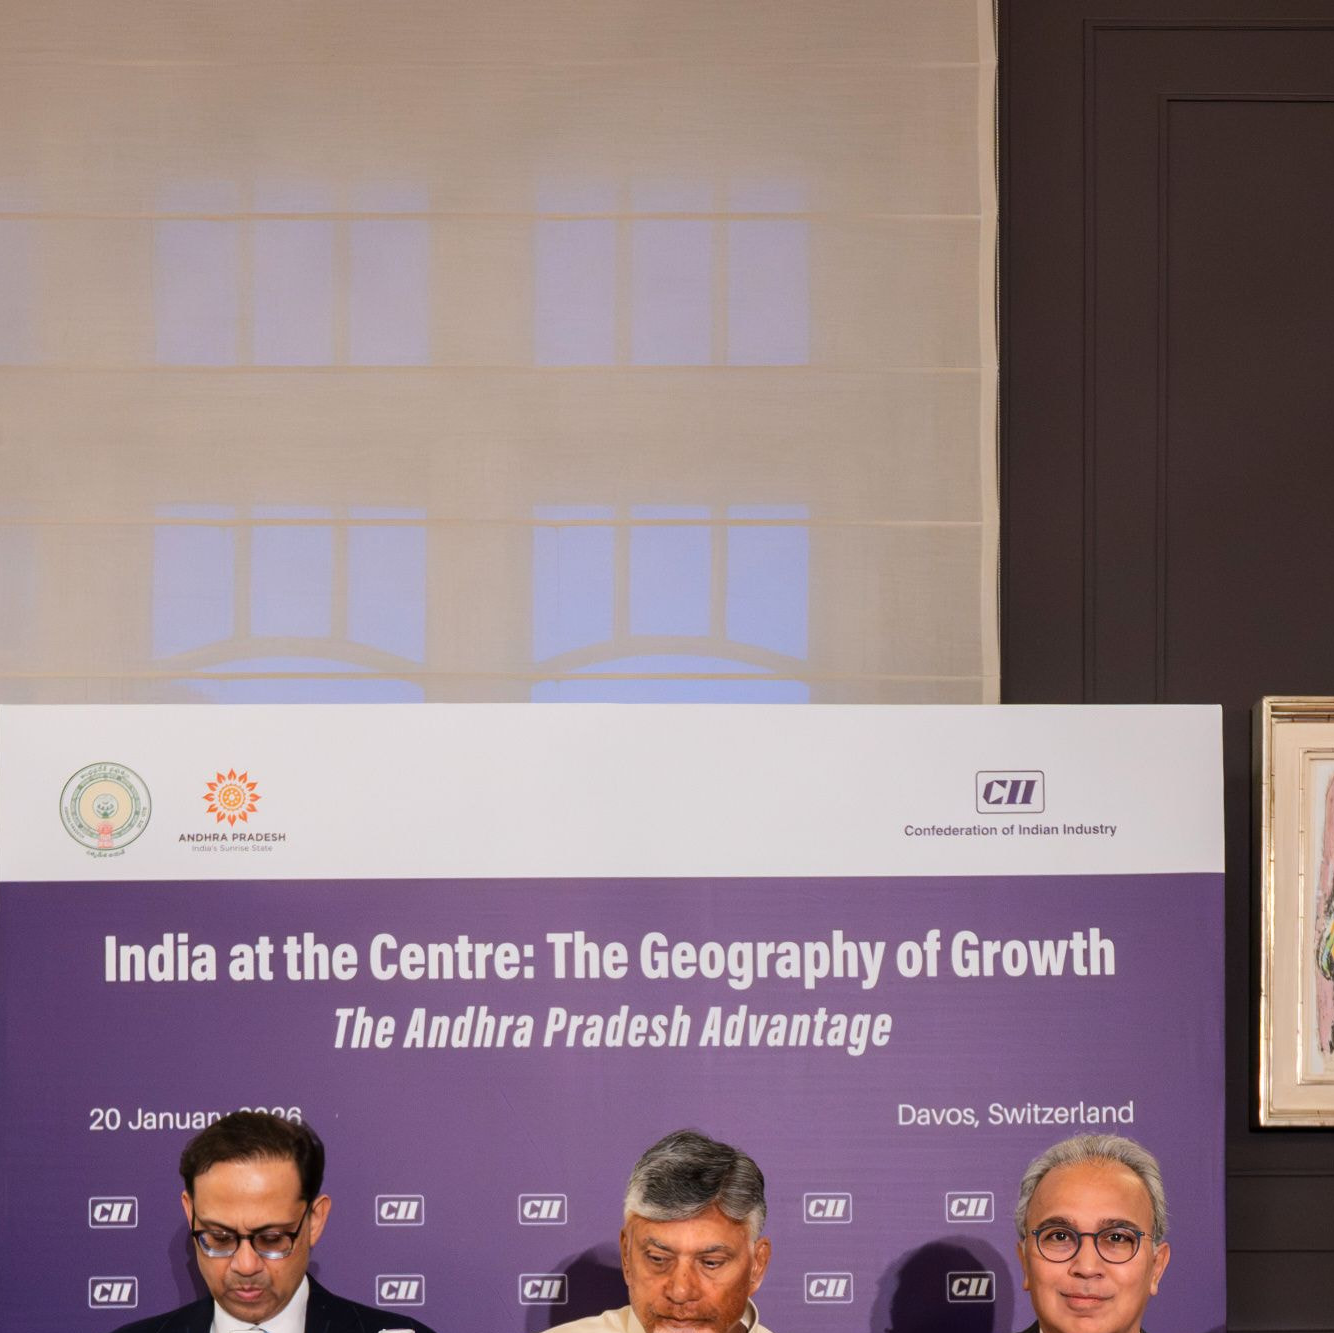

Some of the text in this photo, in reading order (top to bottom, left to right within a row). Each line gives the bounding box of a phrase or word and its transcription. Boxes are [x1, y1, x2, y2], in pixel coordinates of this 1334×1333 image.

[982, 779, 1036, 805] CII
[178, 832, 286, 843] ANDHRA PRADESH
[904, 823, 1117, 838] Confederation of Indian Industry
[191, 844, 273, 852] India's Sunrise State
[104, 927, 1116, 990] India at the Centre: The Geography of Growth
[334, 1004, 893, 1056] The Andhra Pradesh Advantage
[89, 1107, 121, 1131] 20
[128, 1107, 230, 1130] Januar
[897, 1101, 1134, 1128] Davos, Switzerland
[93, 1203, 132, 1222] CII
[380, 1201, 419, 1220] CII
[523, 1200, 562, 1219] CII
[808, 1199, 847, 1218] CII
[950, 1198, 989, 1217] CII
[94, 1283, 133, 1302] CII
[381, 1281, 420, 1300] CII
[524, 1280, 563, 1299] CII
[809, 1279, 848, 1298] CII
[951, 1278, 990, 1297] CII
